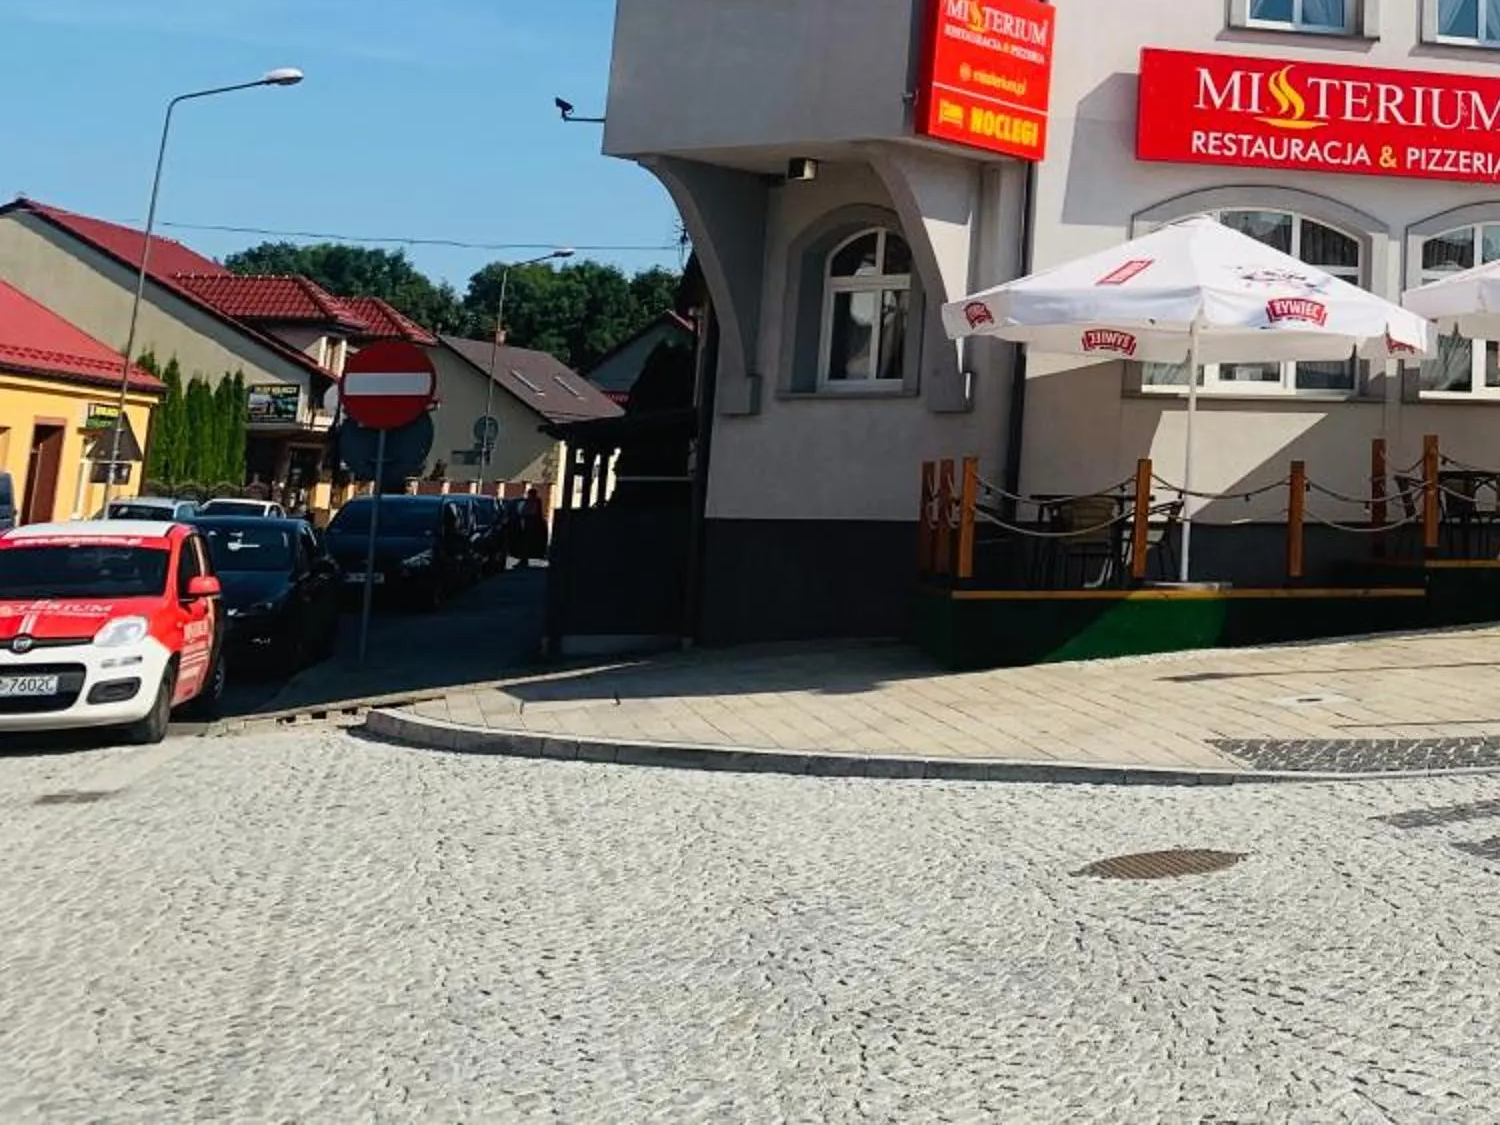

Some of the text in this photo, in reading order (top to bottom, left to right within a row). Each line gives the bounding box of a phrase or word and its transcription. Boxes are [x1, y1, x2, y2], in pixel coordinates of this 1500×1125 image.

[971, 107, 1038, 146] NOCLEGI
[1191, 130, 1372, 166] RESTAURACJA
[1379, 145, 1397, 168] &
